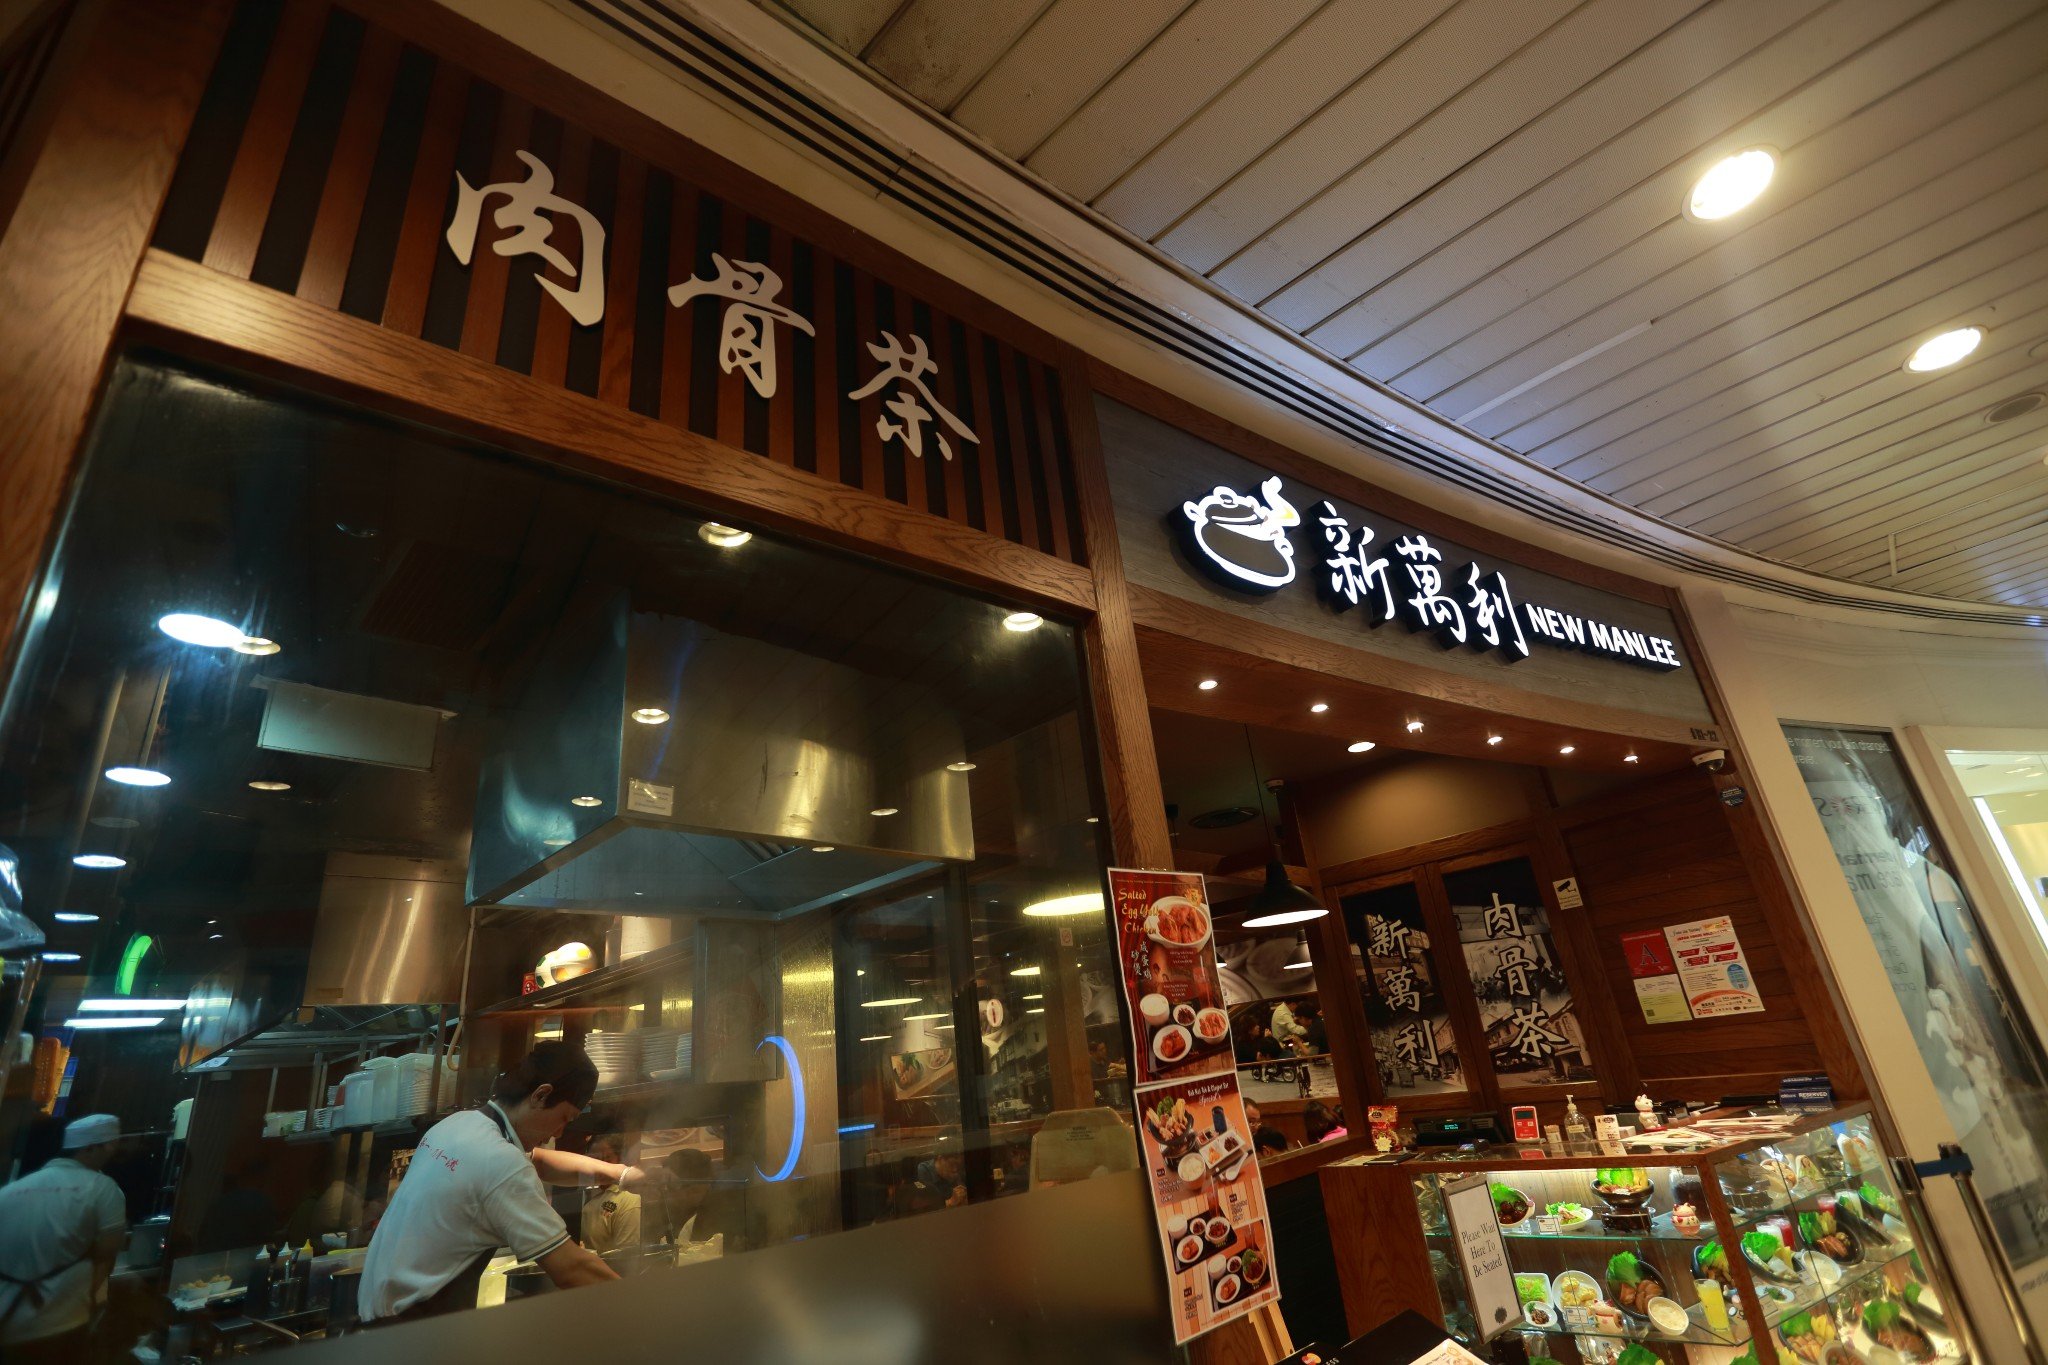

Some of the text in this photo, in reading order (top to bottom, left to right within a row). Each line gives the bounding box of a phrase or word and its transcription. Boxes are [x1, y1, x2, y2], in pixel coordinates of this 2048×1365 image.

[446, 149, 980, 461] 肉骨茶
[1319, 500, 1529, 656] 新萬利
[1525, 603, 1681, 667] NEW MANLEE
[1118, 888, 1147, 901] Salted
[1121, 904, 1138, 920] Egg
[1124, 921, 1158, 935] Chicken
[1640, 942, 1661, 966] A
[1483, 893, 1569, 1058] 肉骨茶
[1371, 914, 1439, 1066] 新萬利
[1461, 1221, 1496, 1245] Please Wait
[1470, 1239, 1496, 1260] Here To
[1473, 1253, 1503, 1278] Be Seated
